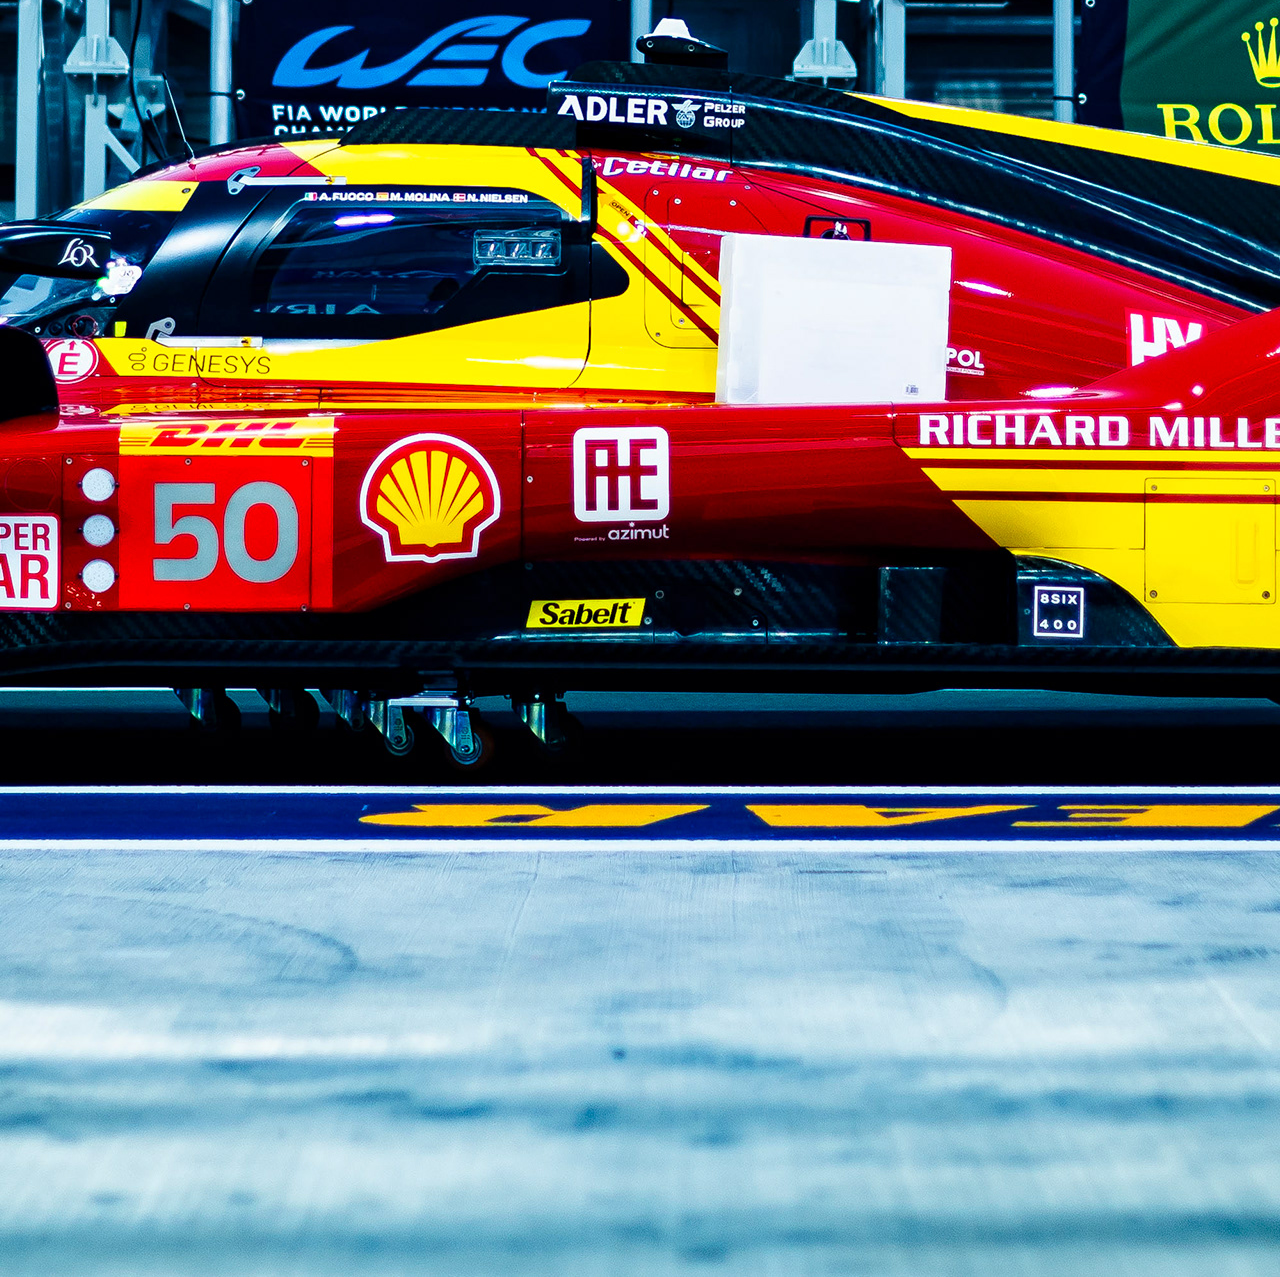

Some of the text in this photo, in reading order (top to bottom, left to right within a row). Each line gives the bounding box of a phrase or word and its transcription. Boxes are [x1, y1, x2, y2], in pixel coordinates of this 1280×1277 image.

[271, 16, 591, 89] WEC
[272, 104, 312, 121] FIA
[557, 94, 746, 125] ADLER PELZER
[703, 116, 746, 130] GROUP
[603, 157, 733, 181] Cetilar
[611, 201, 630, 217] OPEN
[58, 353, 81, 374] E
[153, 354, 271, 374] GENESYS
[946, 347, 985, 369] POL
[149, 422, 306, 448] DHL
[919, 413, 1128, 446] RICHARD
[153, 481, 299, 583] 50
[608, 522, 669, 540] azimut
[1040, 593, 1077, 605] 8SIX
[539, 602, 632, 625] Sabelt
[1039, 619, 1078, 631] 400
